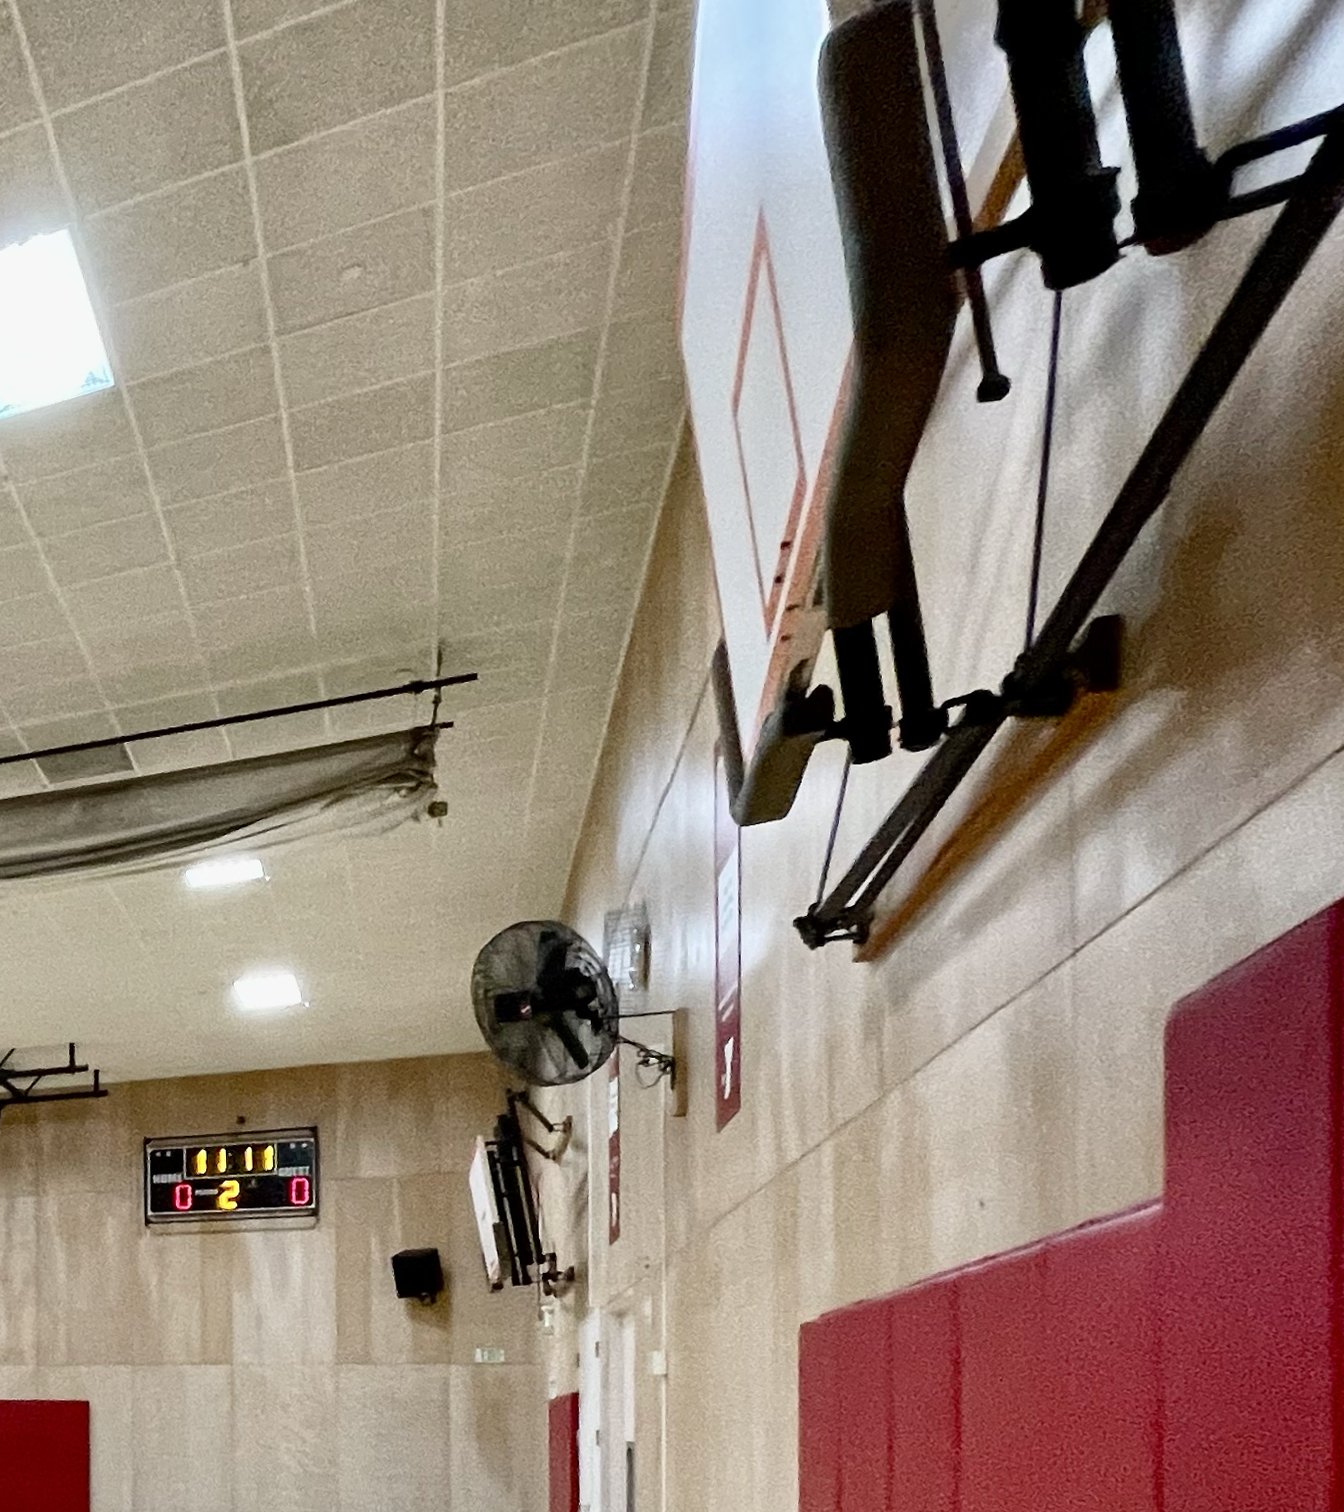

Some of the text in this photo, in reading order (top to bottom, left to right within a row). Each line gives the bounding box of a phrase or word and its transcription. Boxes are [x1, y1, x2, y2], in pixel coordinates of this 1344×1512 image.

[175, 1184, 192, 1210] 0
[218, 1179, 240, 1210] 2
[291, 1177, 310, 1204] 0
